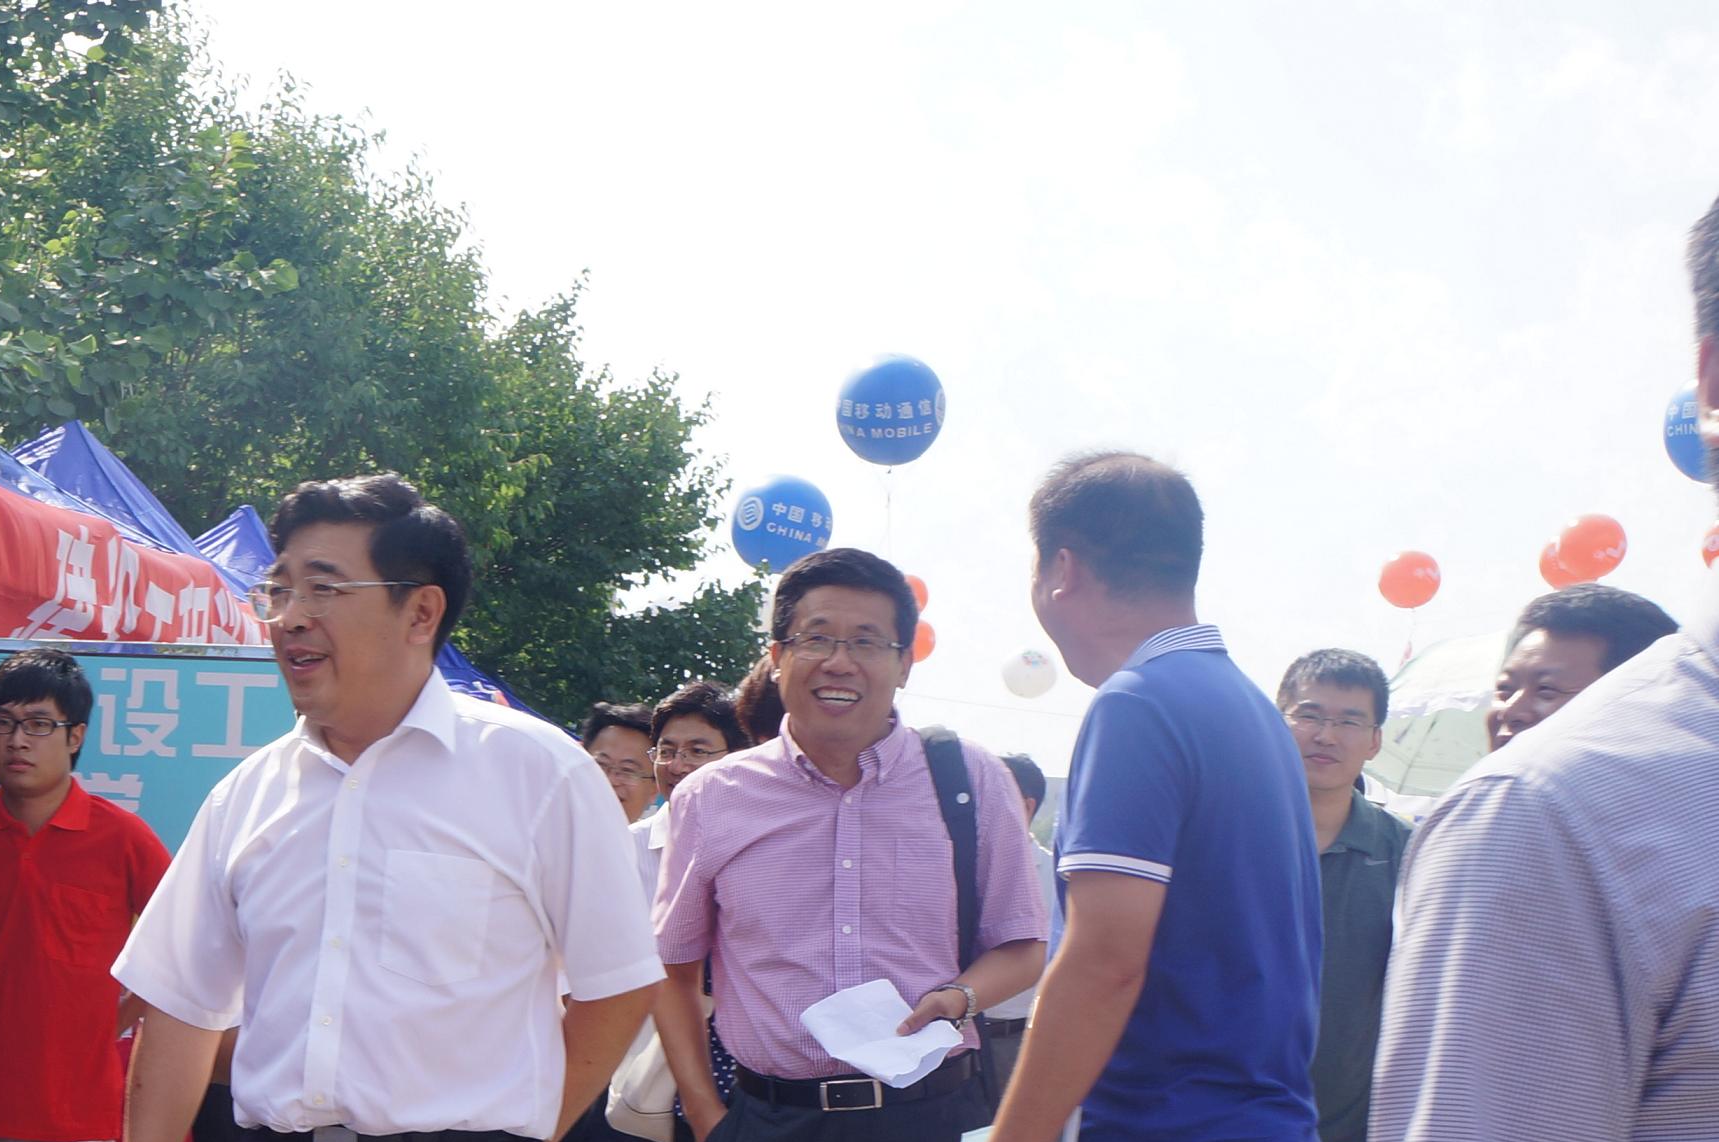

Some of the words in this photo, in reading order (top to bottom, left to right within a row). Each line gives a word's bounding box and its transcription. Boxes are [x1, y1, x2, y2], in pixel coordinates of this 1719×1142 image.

[871, 422, 933, 439] MOBILE
[766, 522, 812, 543] CHINA
[98, 667, 280, 758] 设工
